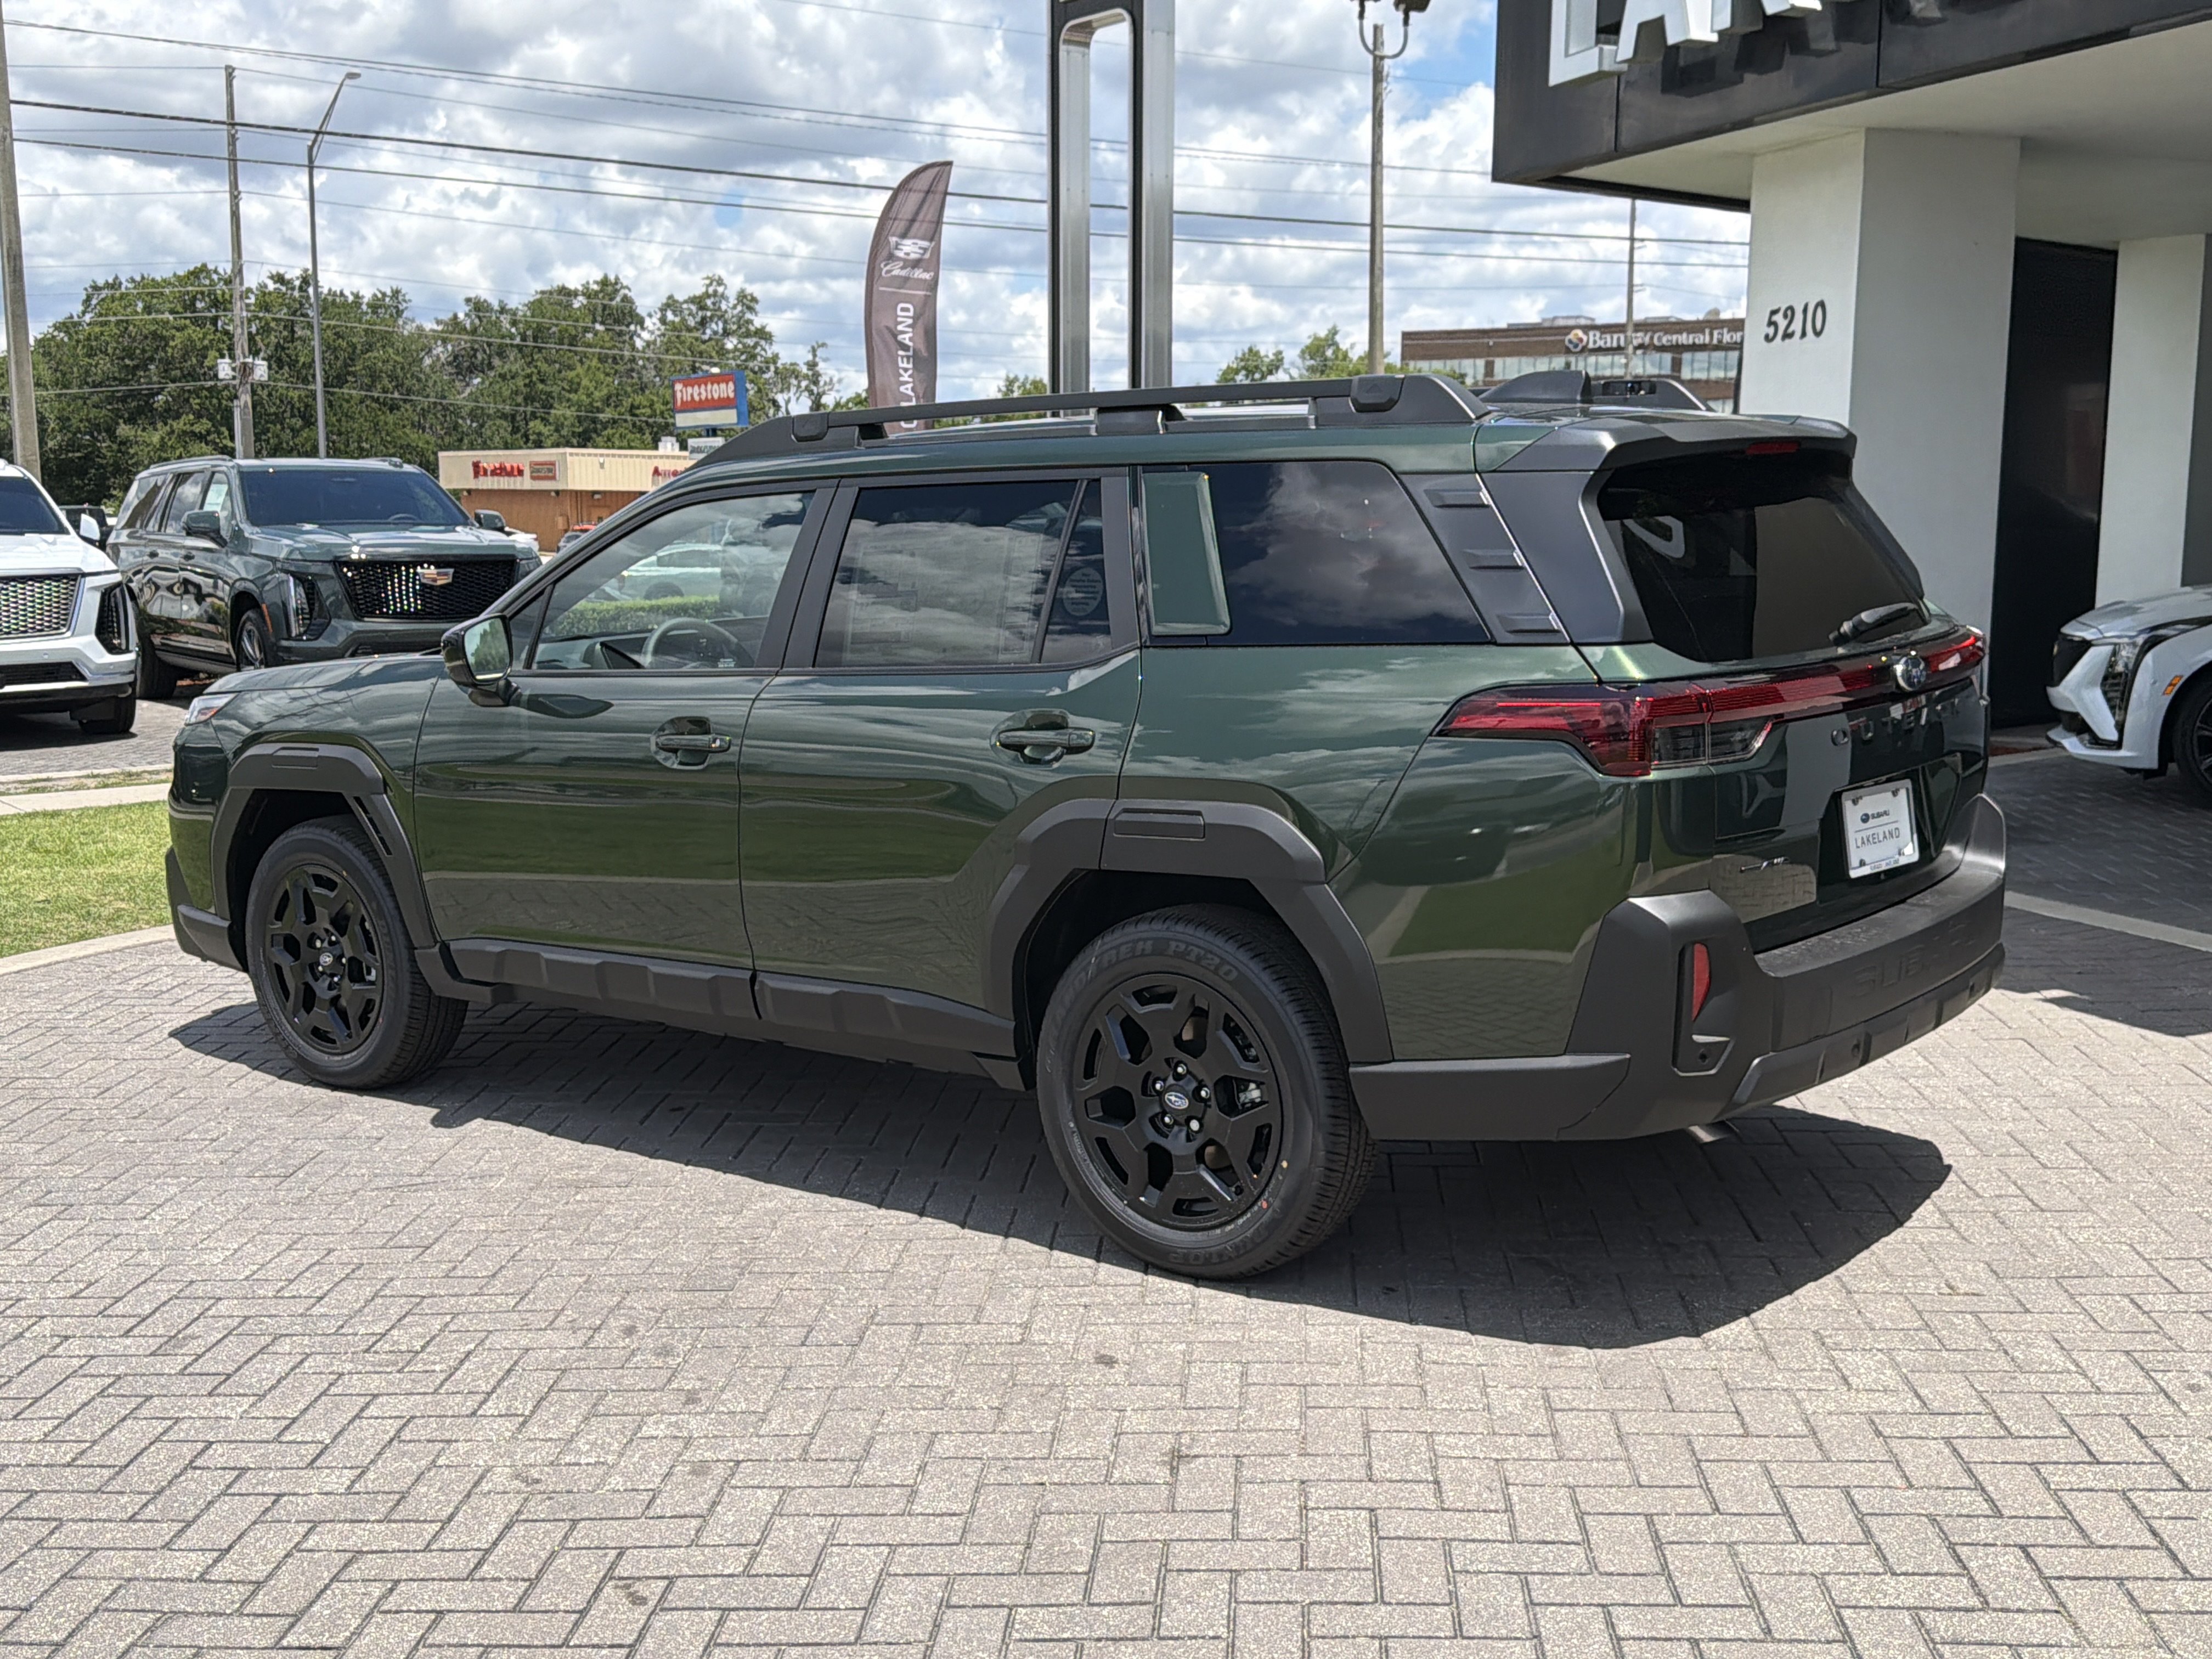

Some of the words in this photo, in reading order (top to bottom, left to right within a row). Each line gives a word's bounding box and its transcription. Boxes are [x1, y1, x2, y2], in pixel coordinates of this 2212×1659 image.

[880, 260, 934, 281] Cadillac
[1764, 298, 1826, 343] 5210
[1654, 328, 1709, 347] Central
[1712, 327, 1743, 345] Flor
[896, 302, 916, 407] LAKELAND
[674, 381, 735, 407] Firestone
[1870, 809, 1891, 820] SUBARU
[1854, 827, 1901, 849] LAKELAND
[1166, 940, 1239, 981] PT20
